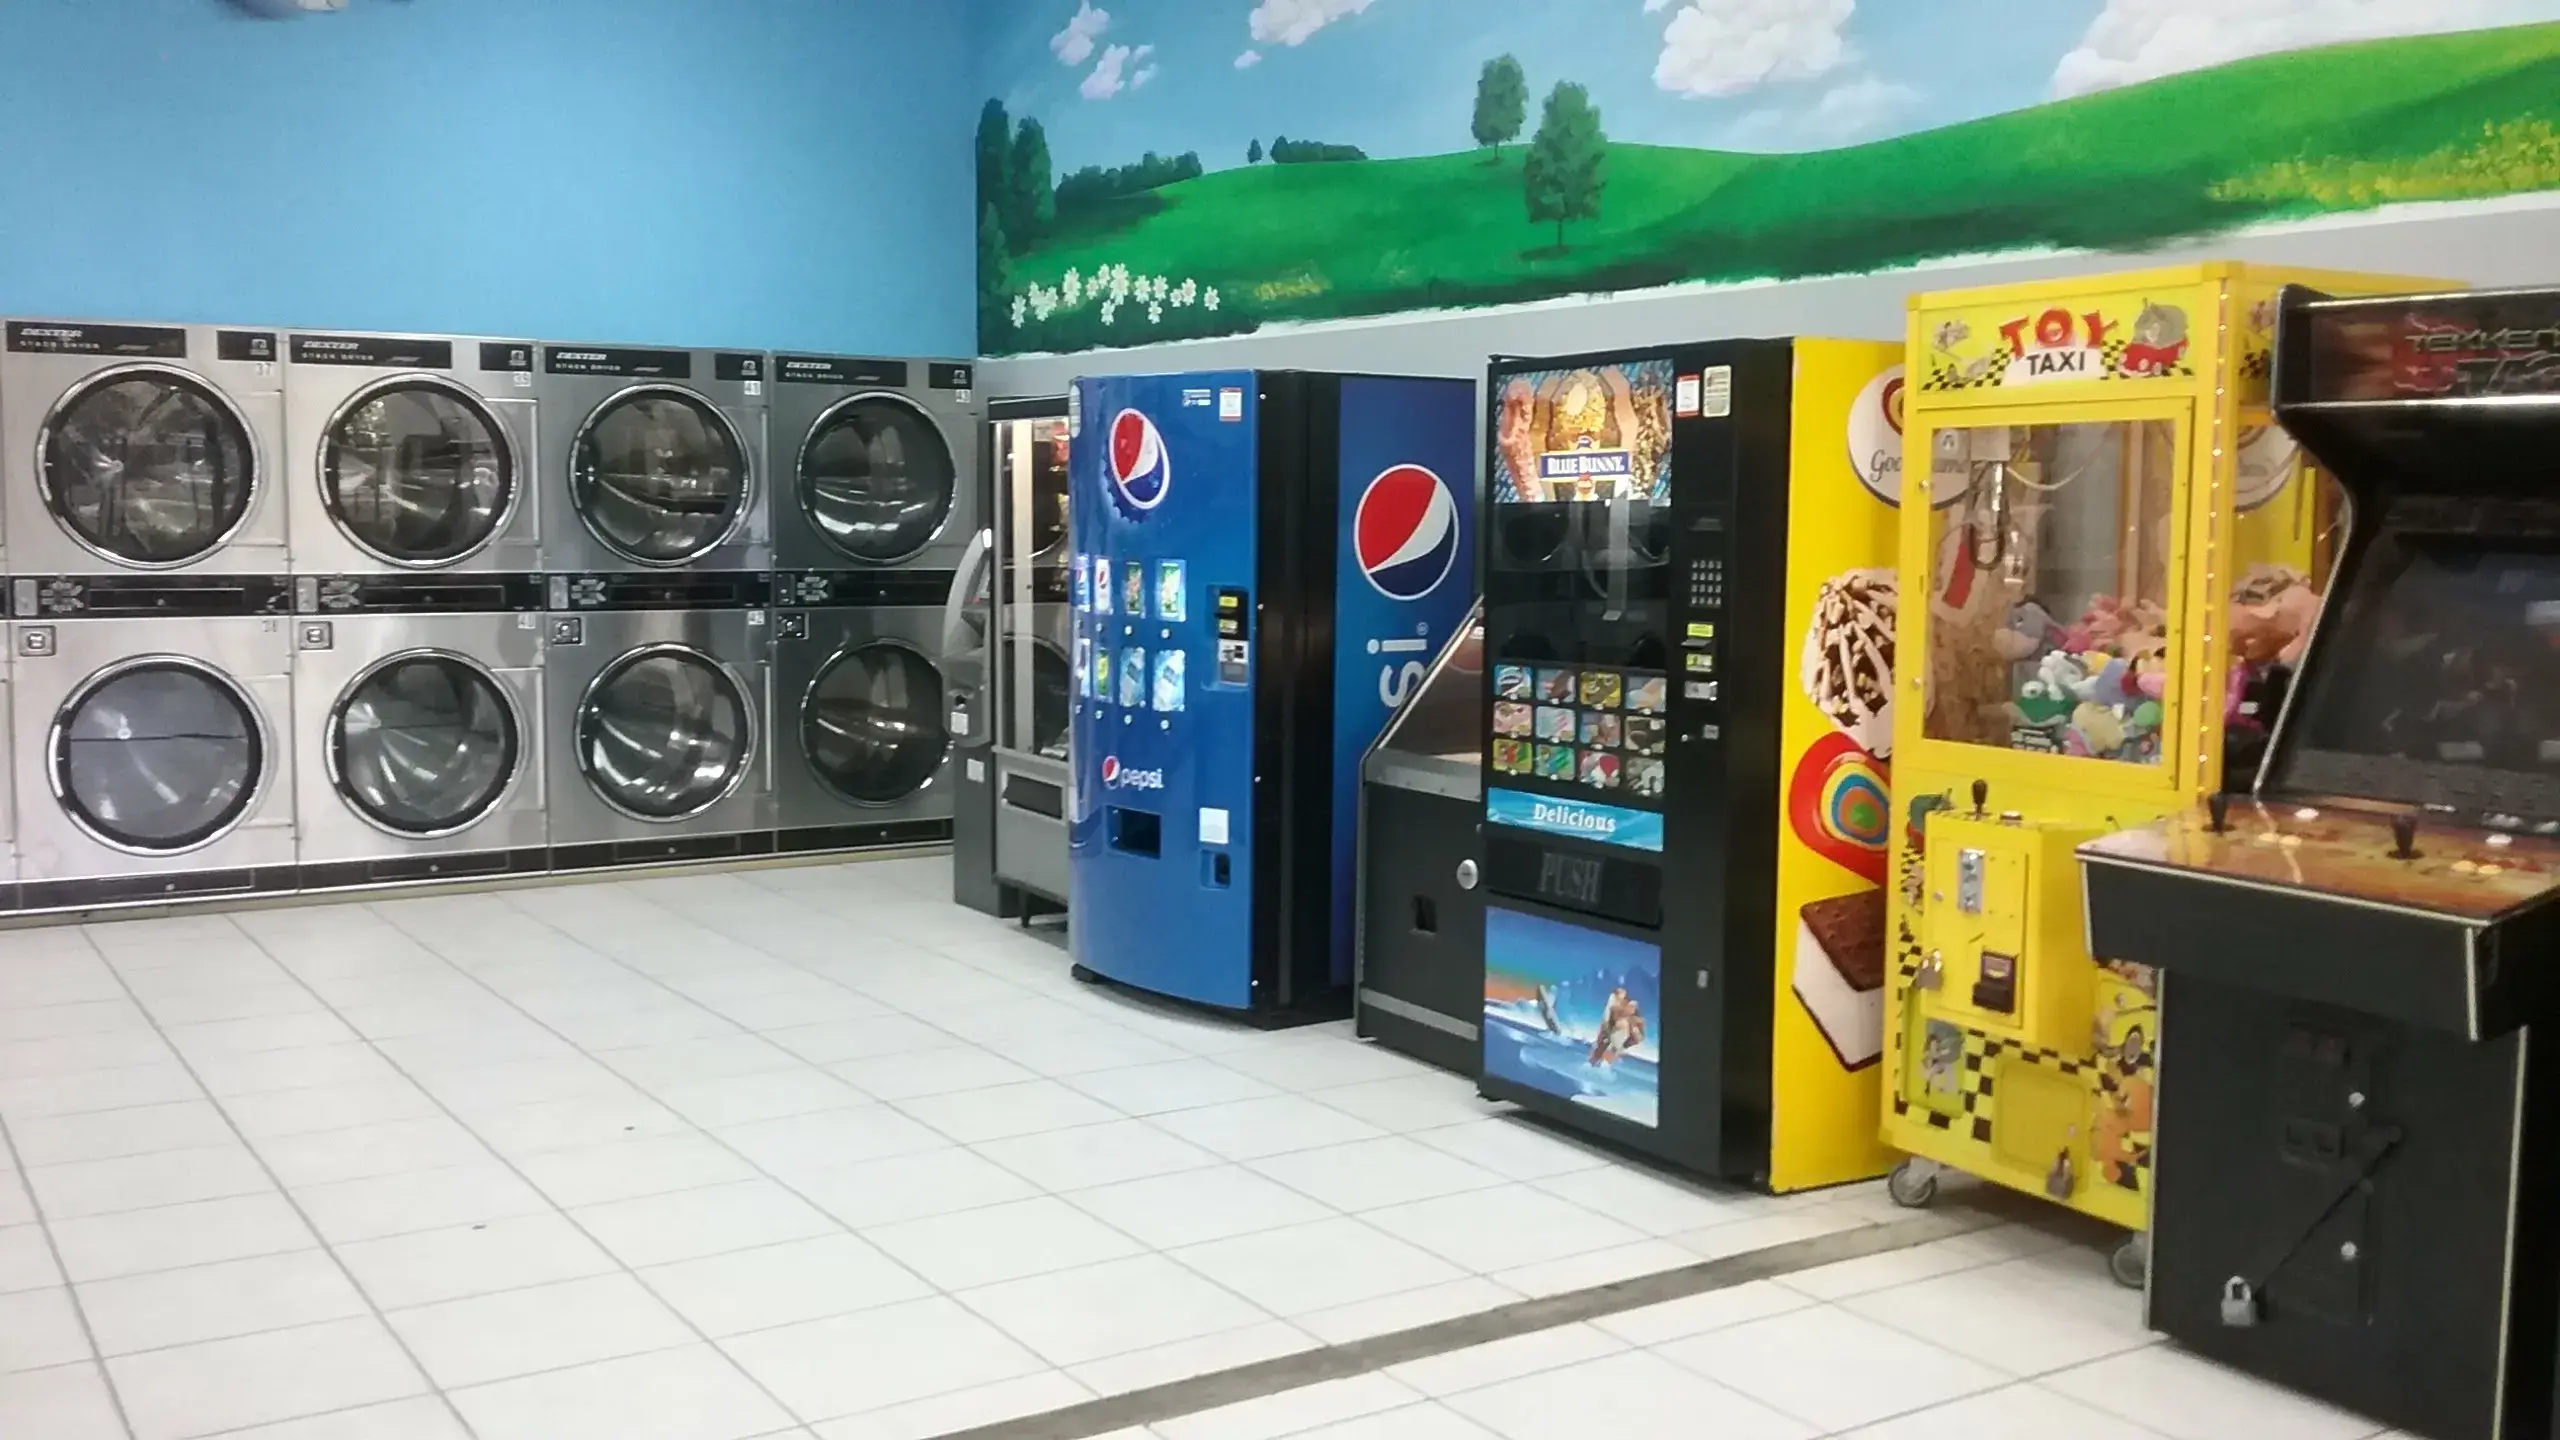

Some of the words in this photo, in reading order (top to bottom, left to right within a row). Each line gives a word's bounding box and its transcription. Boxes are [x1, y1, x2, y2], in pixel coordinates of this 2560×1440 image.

[1999, 307, 2119, 360] TOY
[2026, 350, 2086, 376] TAXI
[1547, 457, 1578, 475] BLUE
[1869, 448, 1903, 483] Goo
[1120, 768, 1163, 791] pepsi
[1533, 803, 1616, 833] Delicious
[1537, 852, 1600, 902] PUSH
